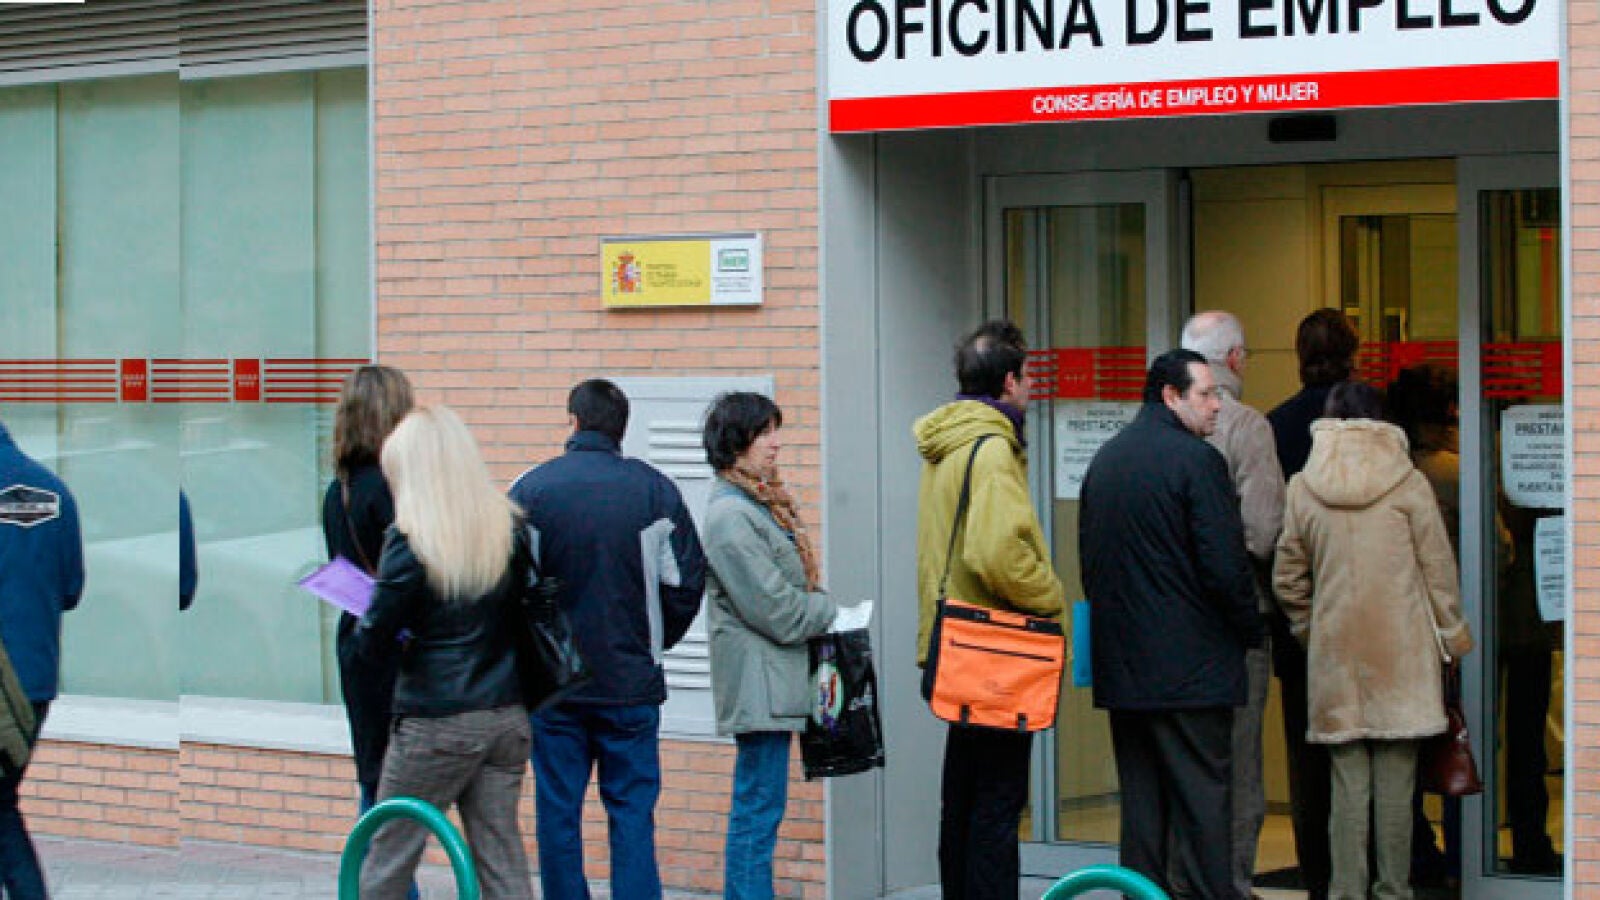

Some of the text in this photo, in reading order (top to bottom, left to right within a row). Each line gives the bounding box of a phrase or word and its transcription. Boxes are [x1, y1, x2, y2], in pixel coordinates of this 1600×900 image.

[846, 0, 1104, 62] OFICINA
[1126, 0, 1213, 45] DE
[1032, 81, 1319, 113] CONSEJERÍA DE EMPLEO Y MUJER
